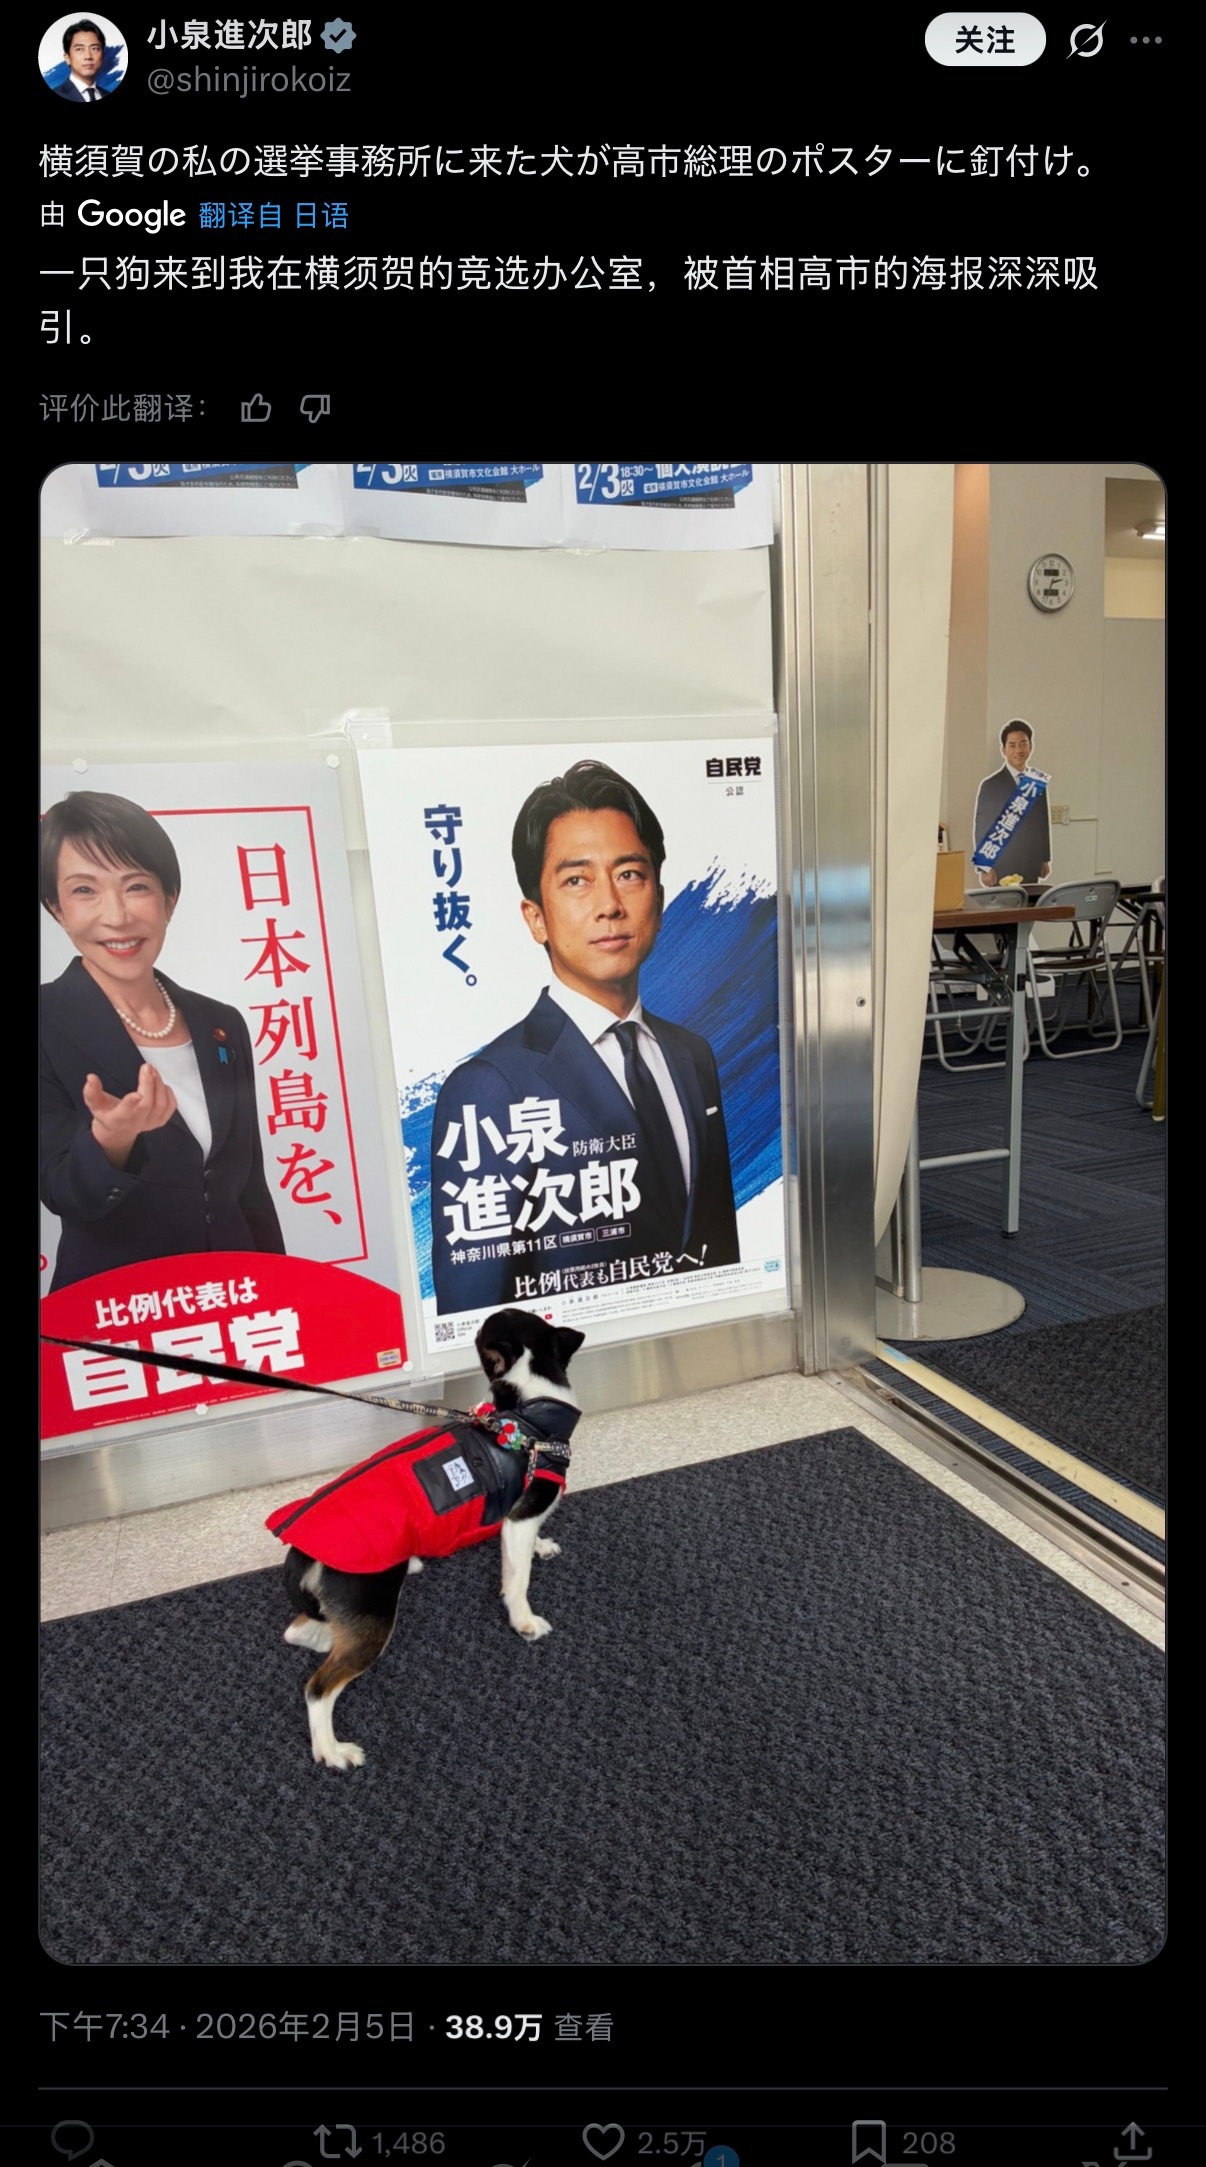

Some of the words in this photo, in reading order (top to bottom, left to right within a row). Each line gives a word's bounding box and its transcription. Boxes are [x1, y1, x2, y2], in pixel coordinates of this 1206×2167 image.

[404, 465, 418, 481] 火
[577, 464, 621, 501] 2/3
[621, 480, 634, 496] 火
[705, 756, 762, 778] 自民党
[979, 780, 1038, 860] 小泉進次郎
[423, 803, 478, 987] 守り抜く。
[236, 842, 343, 1226] 日本列島を、
[437, 1096, 570, 1172] 小泉
[572, 1132, 637, 1157] 防衛大臣
[441, 1157, 642, 1247] 進次郎
[450, 1234, 558, 1265] 神奈川県第11区
[95, 1276, 259, 1329] 比例代表は
[62, 1307, 305, 1412] 自民党
